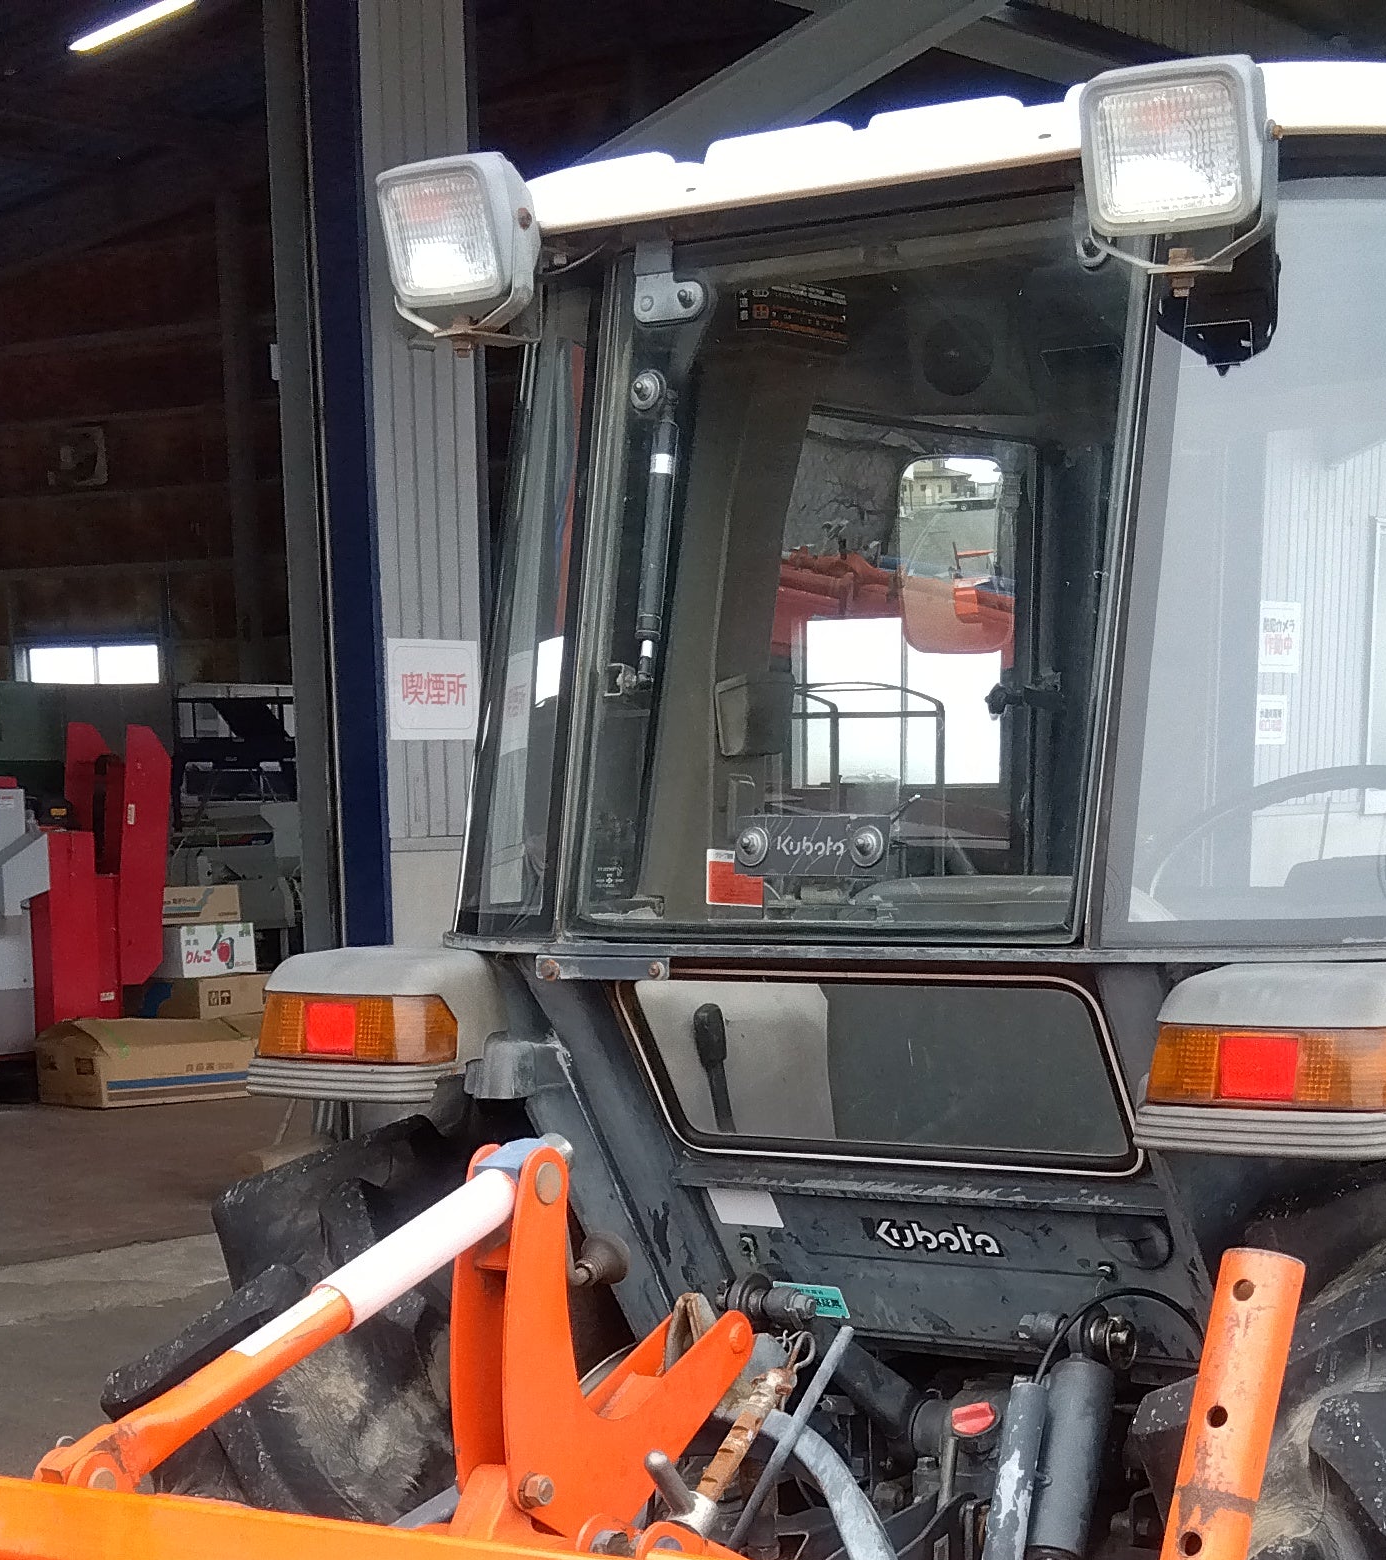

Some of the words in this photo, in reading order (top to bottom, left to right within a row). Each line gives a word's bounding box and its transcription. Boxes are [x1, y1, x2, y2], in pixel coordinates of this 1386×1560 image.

[401, 671, 468, 707] 喫煙所
[776, 834, 846, 857] Kubota
[876, 1220, 1000, 1255] Kubota
